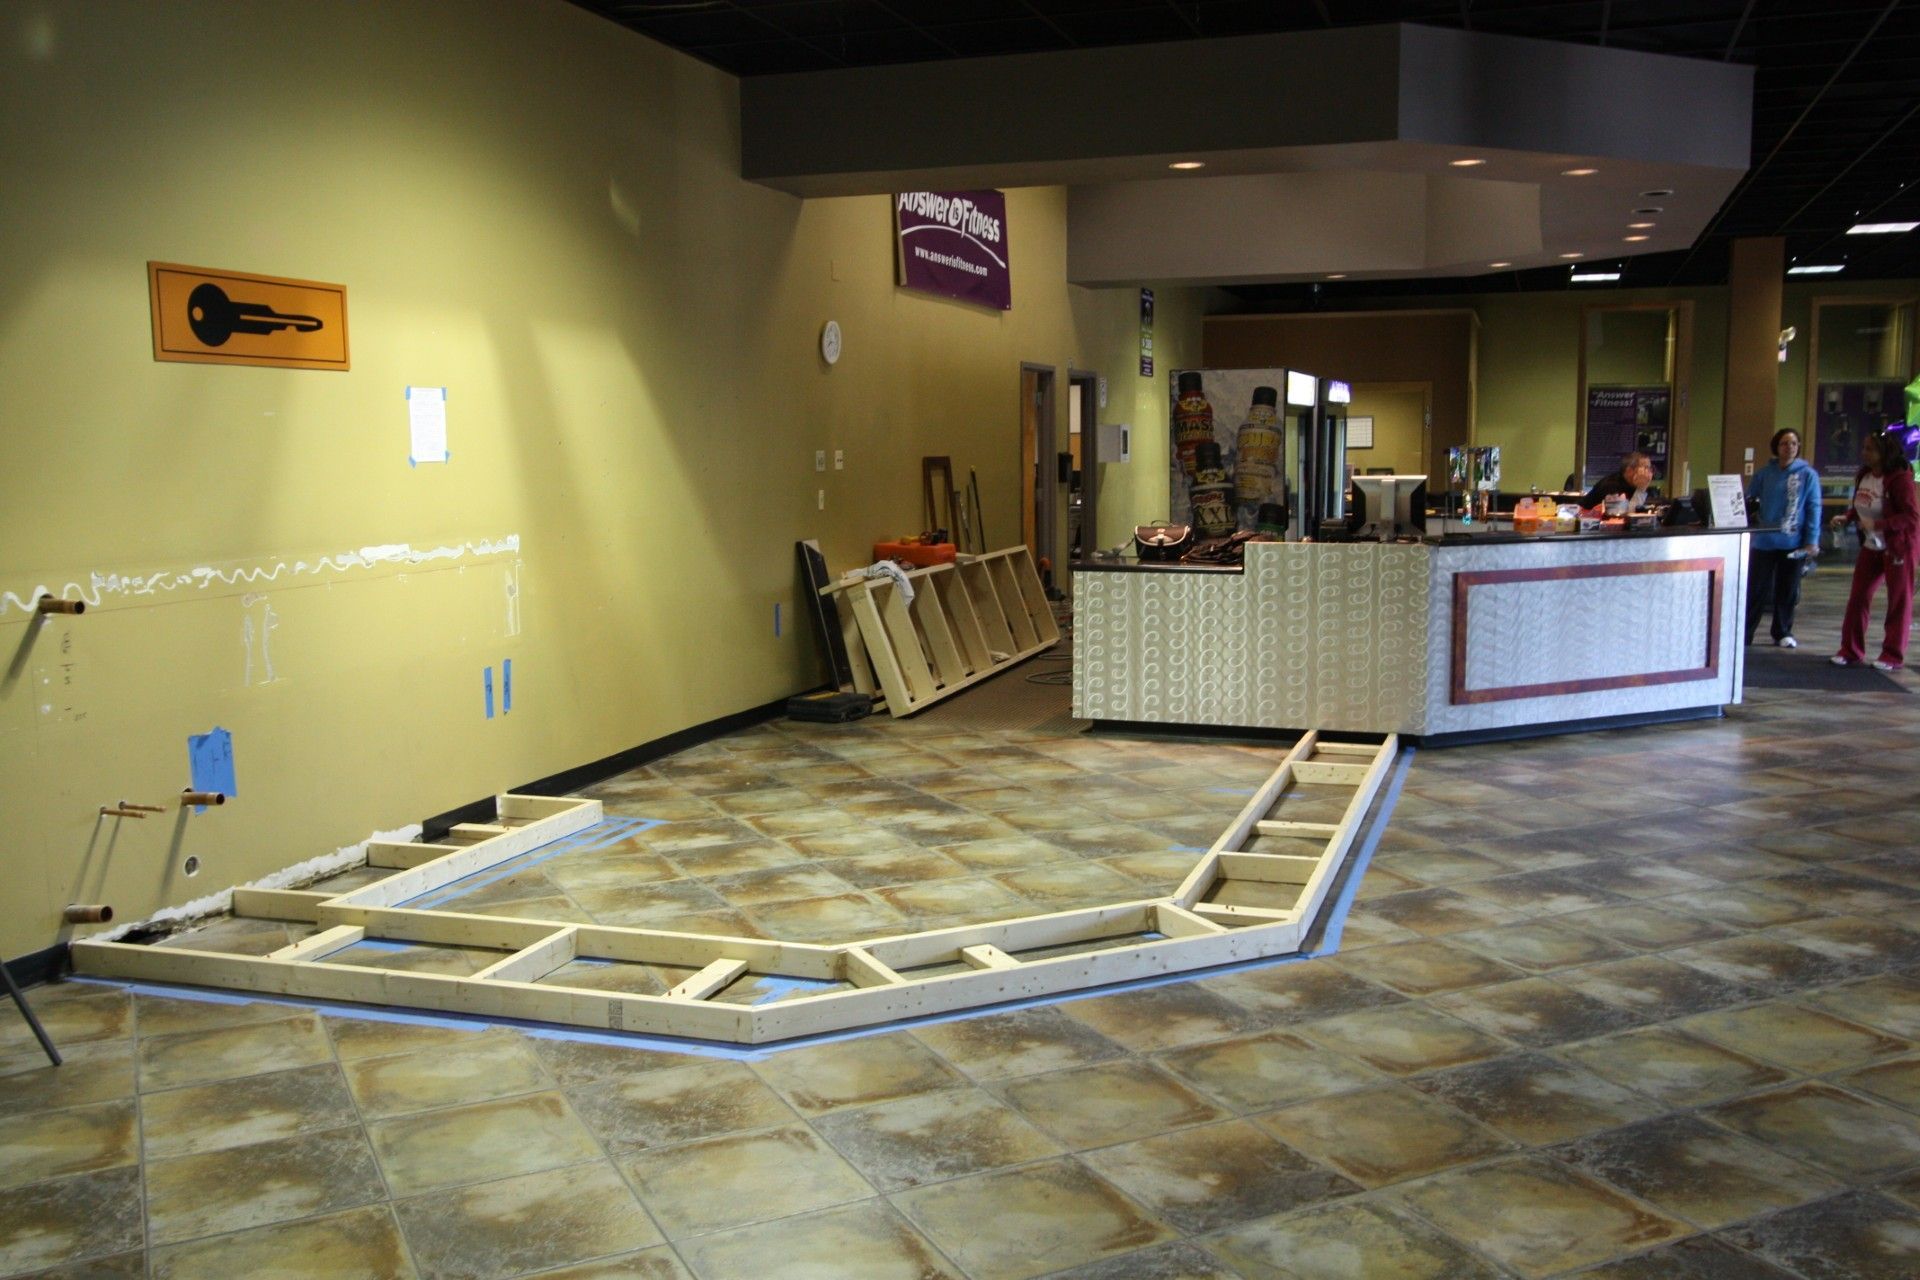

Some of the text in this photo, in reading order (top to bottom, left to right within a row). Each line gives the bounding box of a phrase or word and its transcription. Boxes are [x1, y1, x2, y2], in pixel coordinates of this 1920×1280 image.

[898, 192, 949, 223] Answer
[961, 199, 1000, 243] Fitness
[1597, 391, 1636, 399] Answer
